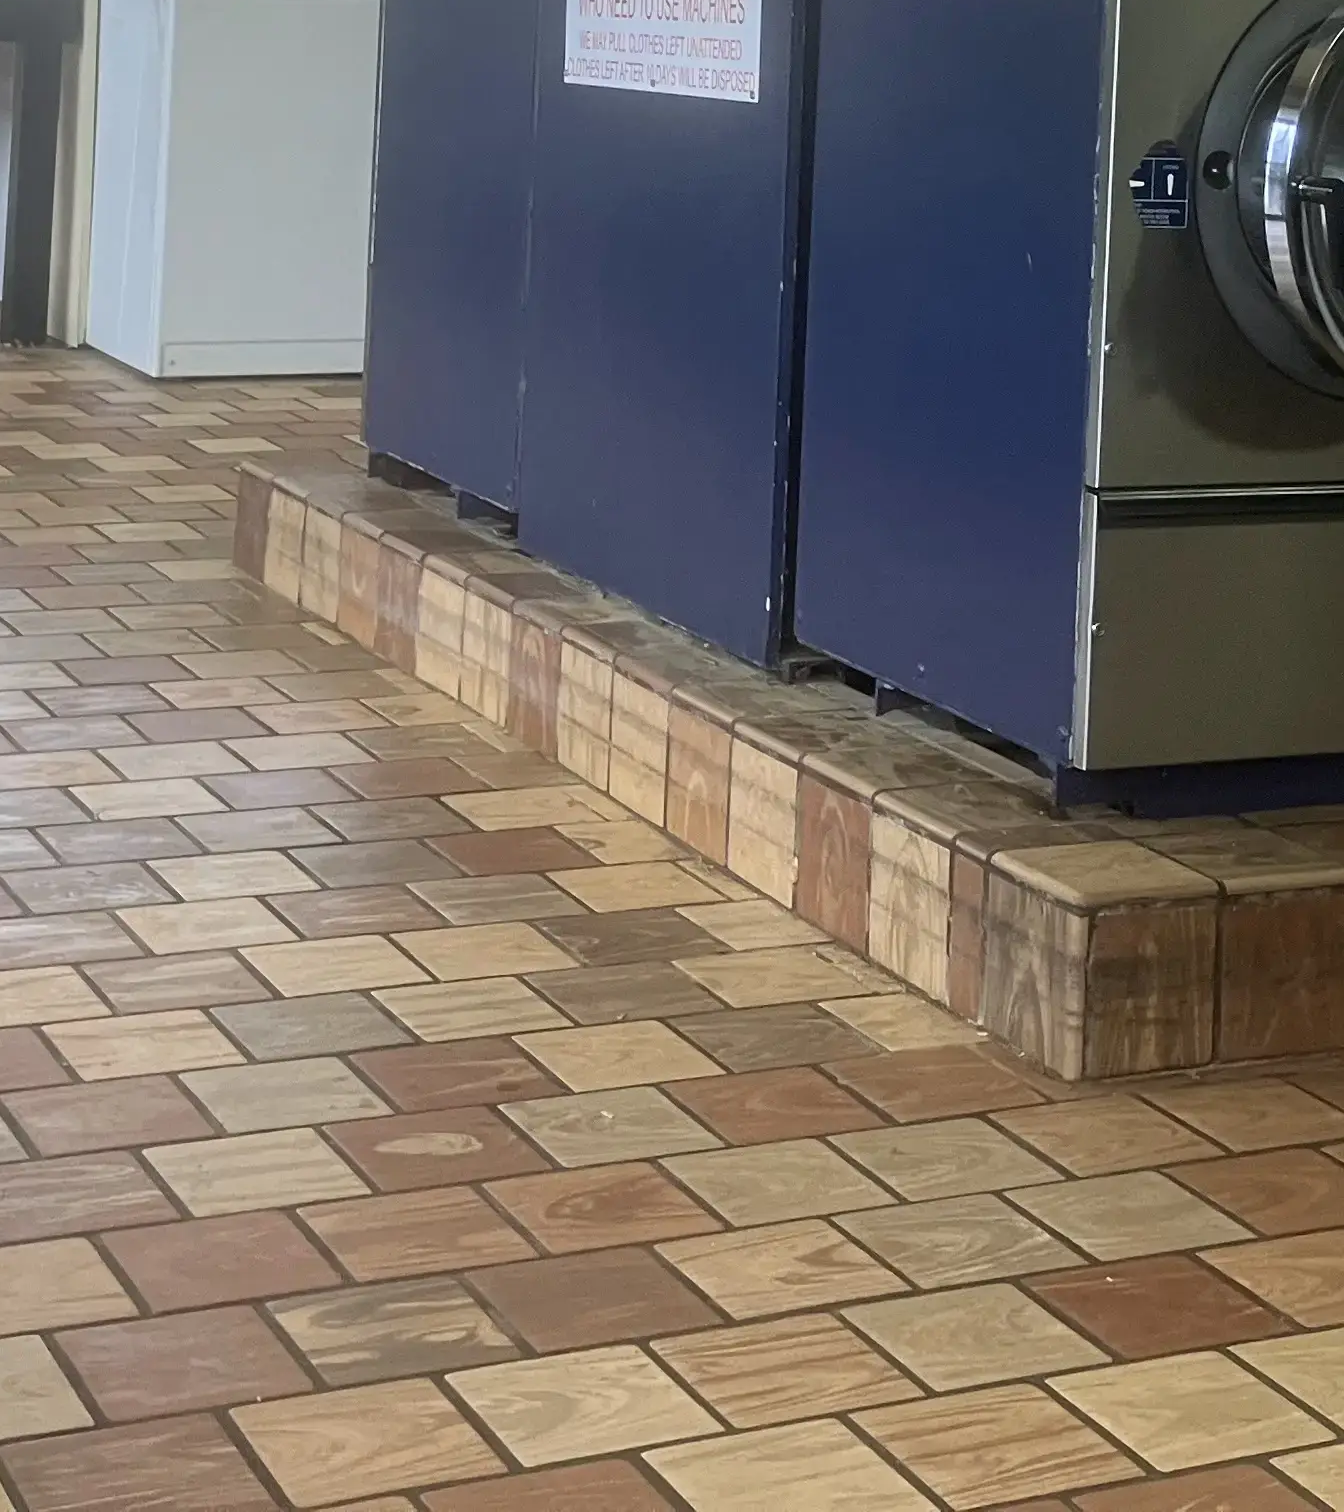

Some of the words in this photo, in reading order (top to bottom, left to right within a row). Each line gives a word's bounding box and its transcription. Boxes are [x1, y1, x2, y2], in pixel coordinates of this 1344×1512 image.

[579, 30, 592, 50] WE
[609, 32, 627, 53] PULL
[629, 33, 664, 55] CLOTHES
[665, 36, 685, 57] LEFT
[687, 37, 743, 61] UNATTENDED
[567, 56, 600, 78] CLOTHES
[601, 59, 619, 80] LEFT
[619, 61, 644, 82] AFTER
[655, 64, 676, 86] DAYS
[698, 68, 710, 89] BE
[711, 69, 755, 94] DISPOSED
